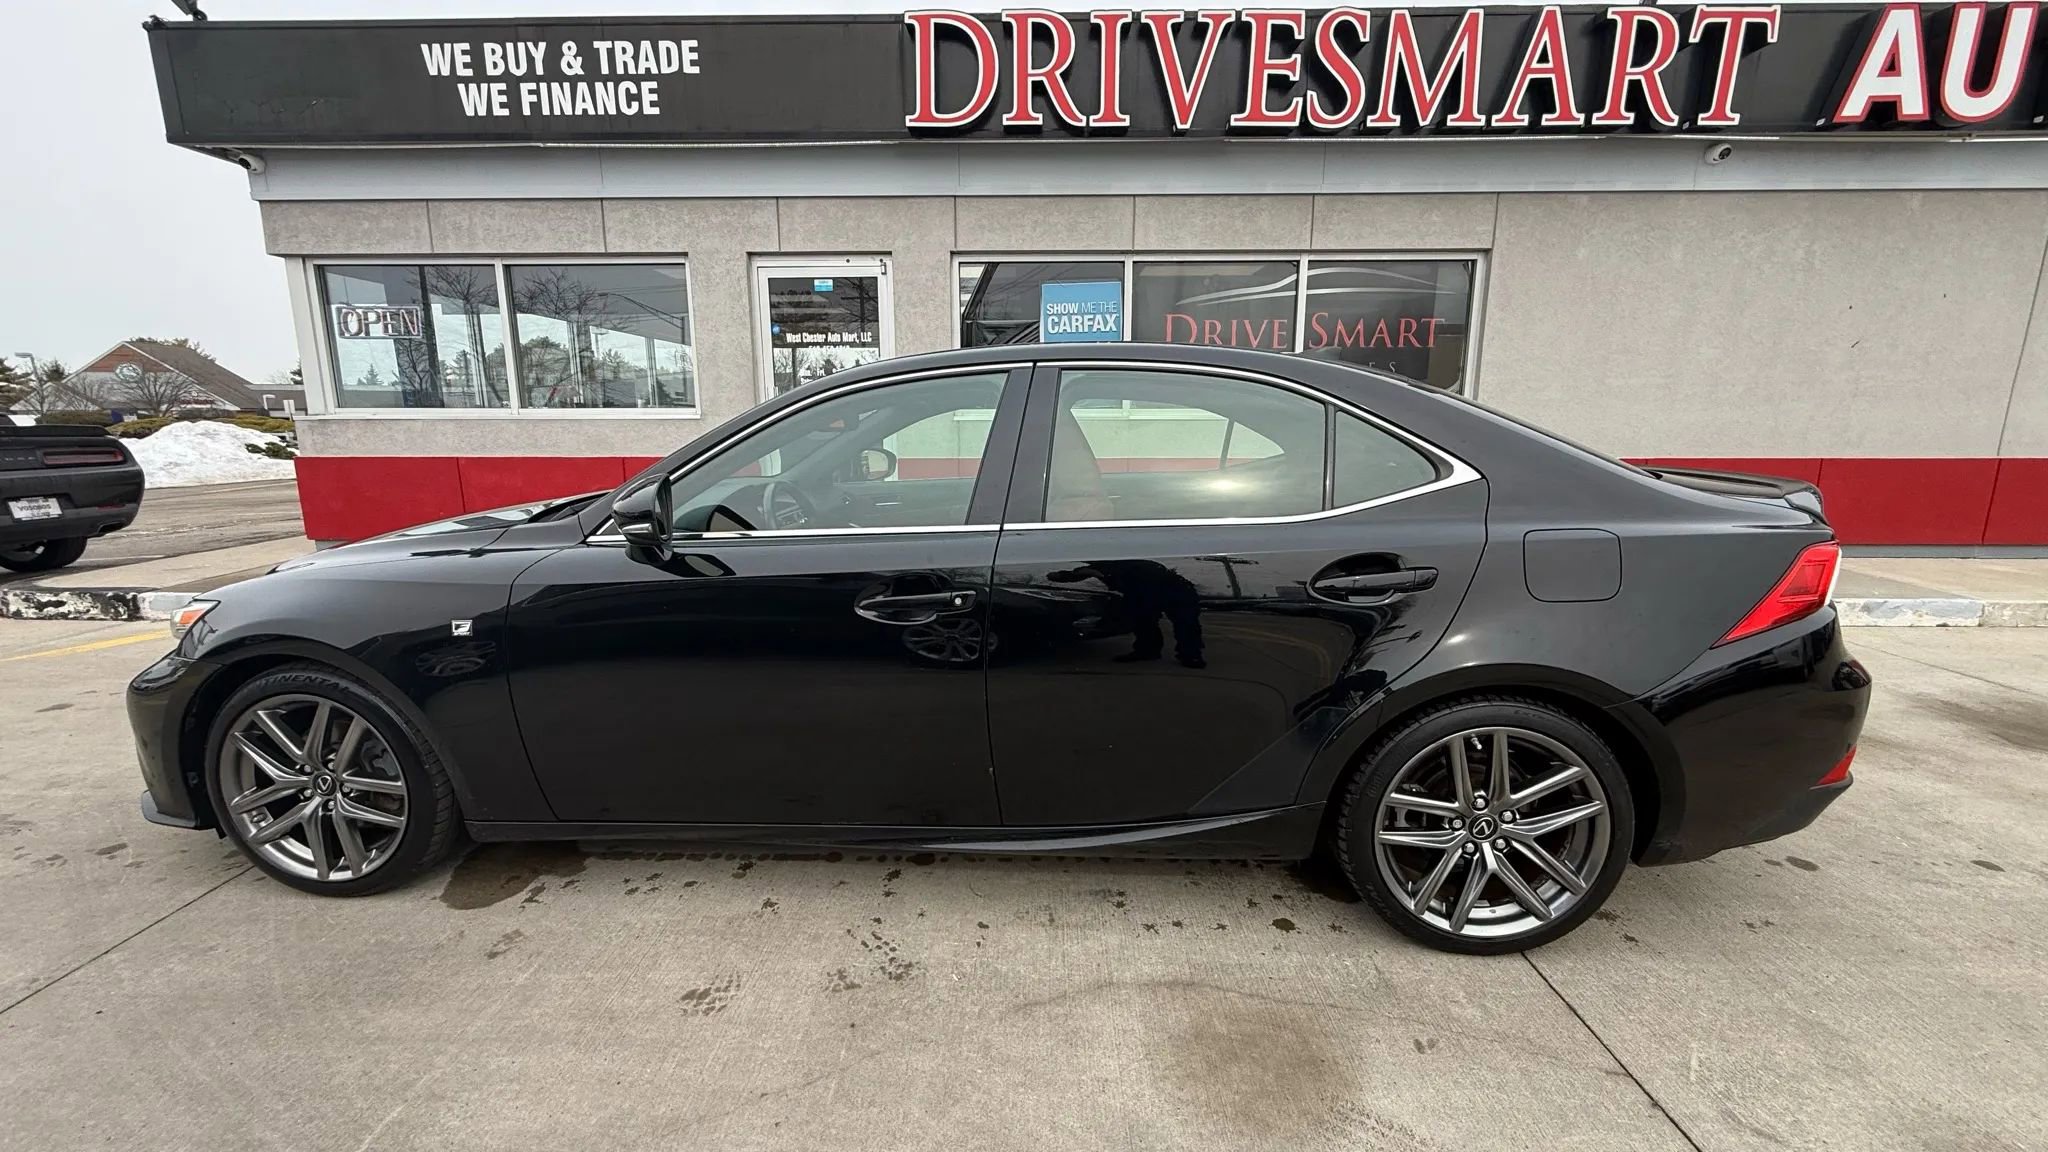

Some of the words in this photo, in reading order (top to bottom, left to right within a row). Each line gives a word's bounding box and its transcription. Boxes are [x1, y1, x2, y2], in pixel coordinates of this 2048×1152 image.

[421, 42, 473, 76] WE
[483, 41, 547, 76] BUY
[560, 40, 585, 75] &
[593, 39, 700, 75] TRADE
[904, 5, 1781, 130] DRIVESMART
[457, 82, 510, 116] WE
[519, 80, 660, 116] FINANCE
[341, 308, 418, 337] OPEN
[1046, 302, 1079, 315] SHOW
[1081, 302, 1096, 313] ME
[1098, 301, 1117, 313] THE
[786, 331, 801, 343] West
[802, 331, 826, 343] Chester
[827, 331, 841, 343] Auto
[842, 331, 859, 344] Mart,
[860, 331, 872, 343] LLC
[1047, 313, 1118, 334] CARFAX
